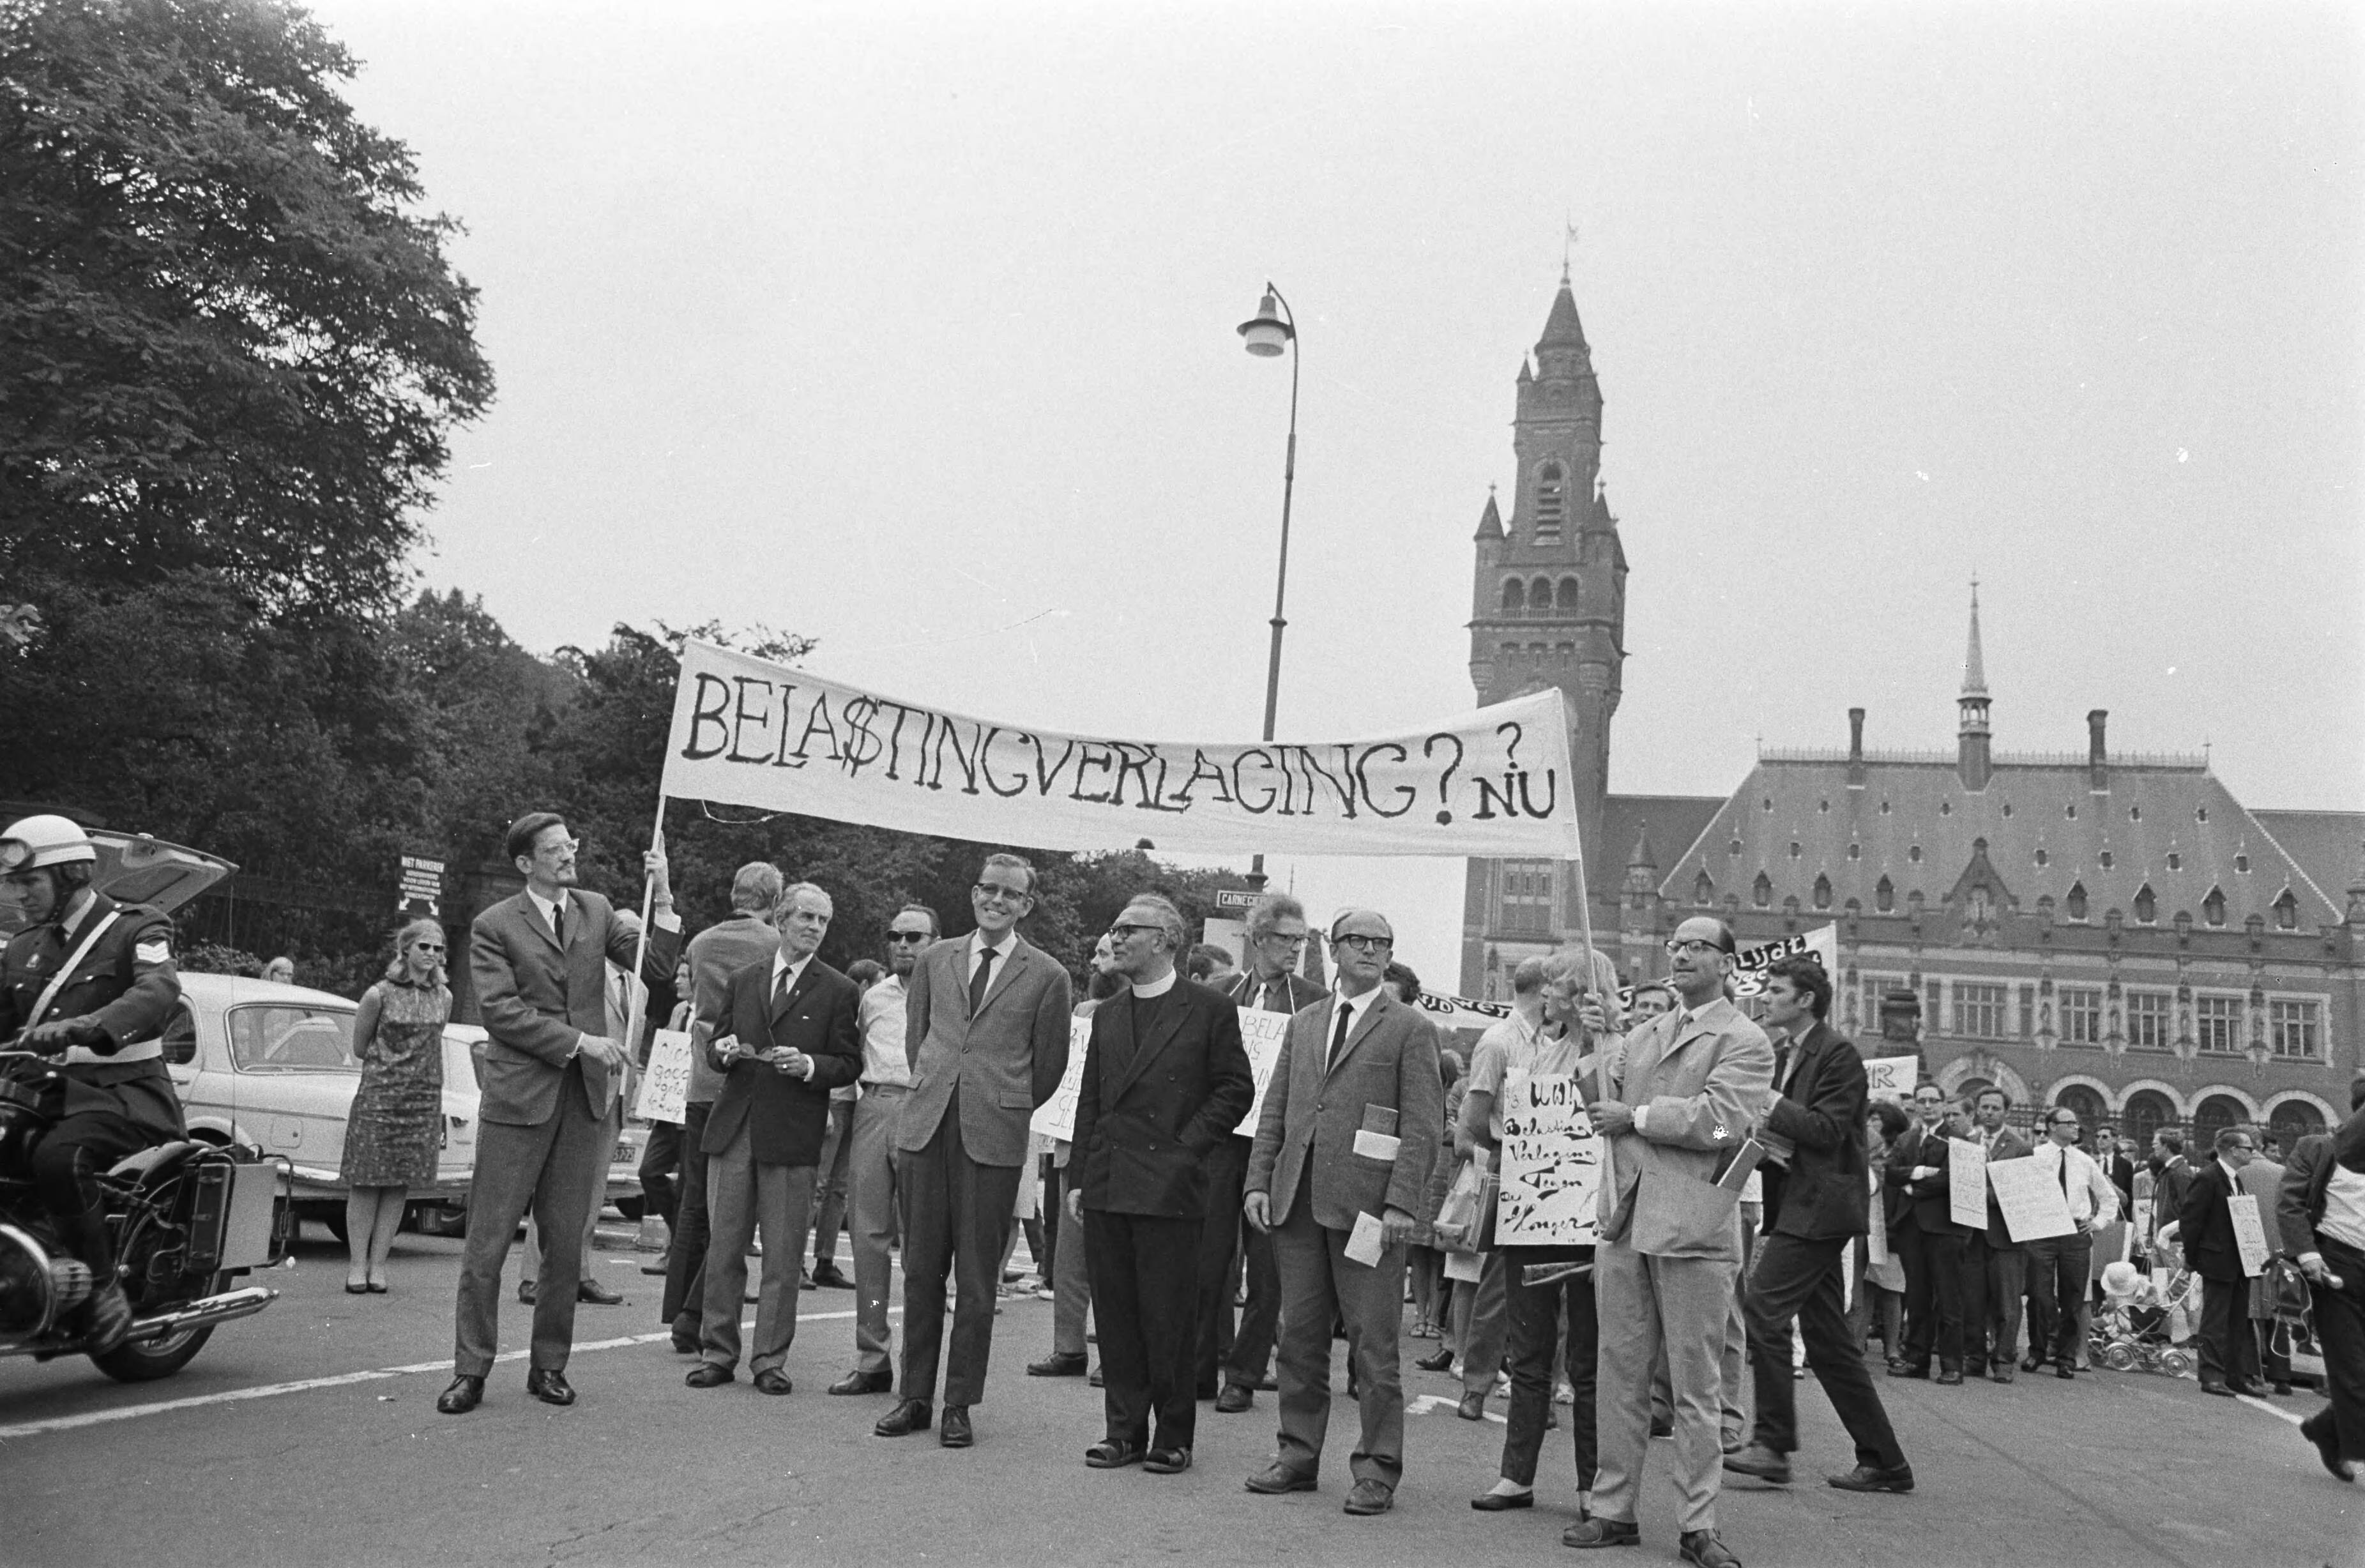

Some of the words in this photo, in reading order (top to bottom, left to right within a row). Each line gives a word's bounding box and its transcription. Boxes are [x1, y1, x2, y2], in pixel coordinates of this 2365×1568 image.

[1471, 768, 1555, 819] NU
[1242, 1015, 1285, 1040] BELA
[1503, 1117, 1593, 1141] Belasting
[1509, 1139, 1597, 1167] Verlaging
[1503, 1203, 1597, 1237] Honger
